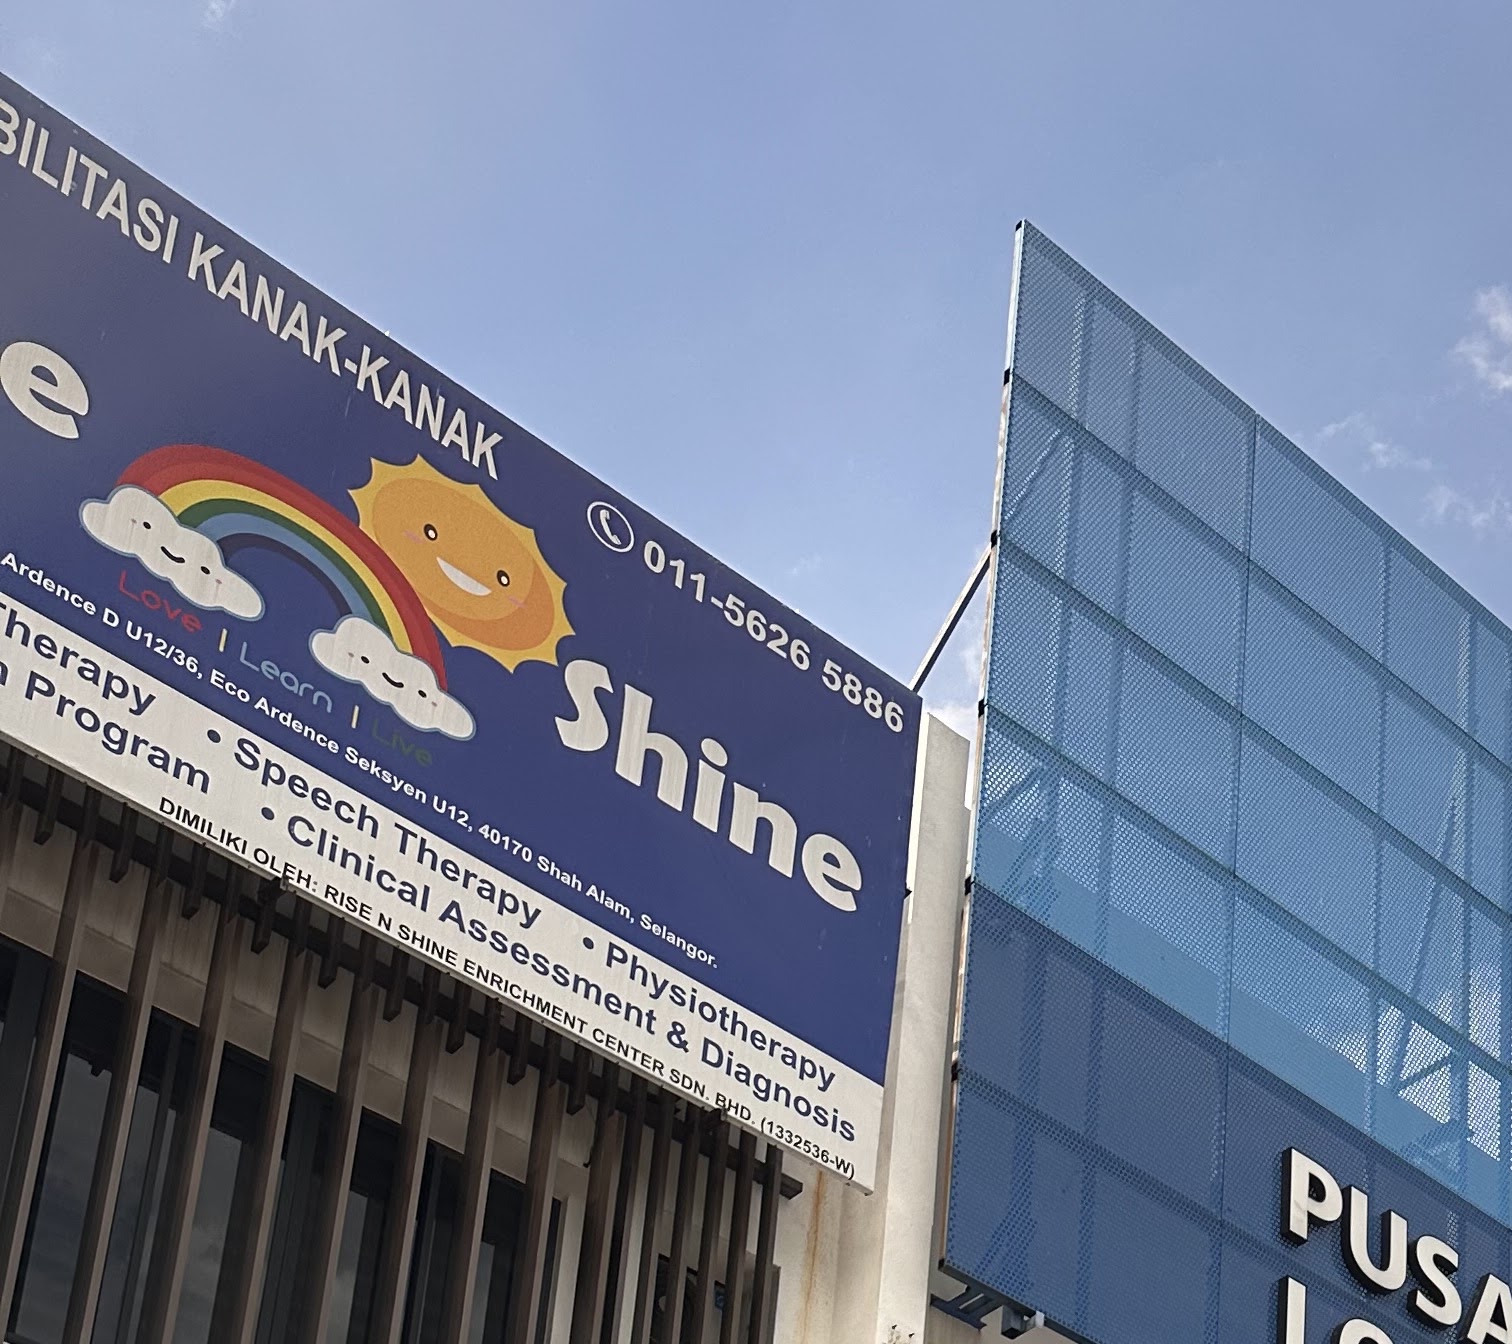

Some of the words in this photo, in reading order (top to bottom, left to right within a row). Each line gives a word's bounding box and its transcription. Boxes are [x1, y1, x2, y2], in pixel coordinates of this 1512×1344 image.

[187, 231, 503, 480] KANAK-KANAK
[0, 602, 157, 716] herapy
[25, 670, 210, 794] Program
[119, 570, 203, 634] Love
[239, 642, 333, 713] Learn
[643, 539, 811, 672] 011-5626
[821, 658, 904, 733] 5886
[1, 552, 97, 616] Ardence
[102, 607, 120, 628] D
[126, 620, 203, 680] U12/36,
[210, 668, 250, 703] Eco
[254, 695, 340, 754] Ardence
[344, 745, 428, 805] Seksyen
[432, 794, 474, 833] U12,
[478, 823, 533, 864] 40170
[536, 855, 583, 892] Shah
[585, 884, 635, 925] Alam,
[639, 913, 718, 969] Selangor.
[234, 737, 380, 838] Speech
[394, 822, 542, 929] Therapy
[554, 659, 862, 912] Shine
[159, 796, 248, 856] DIMILIKI
[253, 847, 318, 895] OLEH:
[324, 884, 372, 922] RISE
[378, 910, 392, 931] N
[398, 923, 458, 967] SHINE
[463, 958, 588, 1035] ENRICHMENT
[592, 1027, 666, 1077] CENTER
[669, 1067, 710, 1101] SDN.
[715, 1093, 756, 1125] BHD.
[760, 1117, 857, 1180] (1332536-W)
[287, 814, 431, 912] Clinical
[439, 899, 656, 1036] Assessment
[667, 1020, 690, 1053] &
[701, 1037, 856, 1142] Diagnosis
[606, 941, 836, 1092] Physiotherapy
